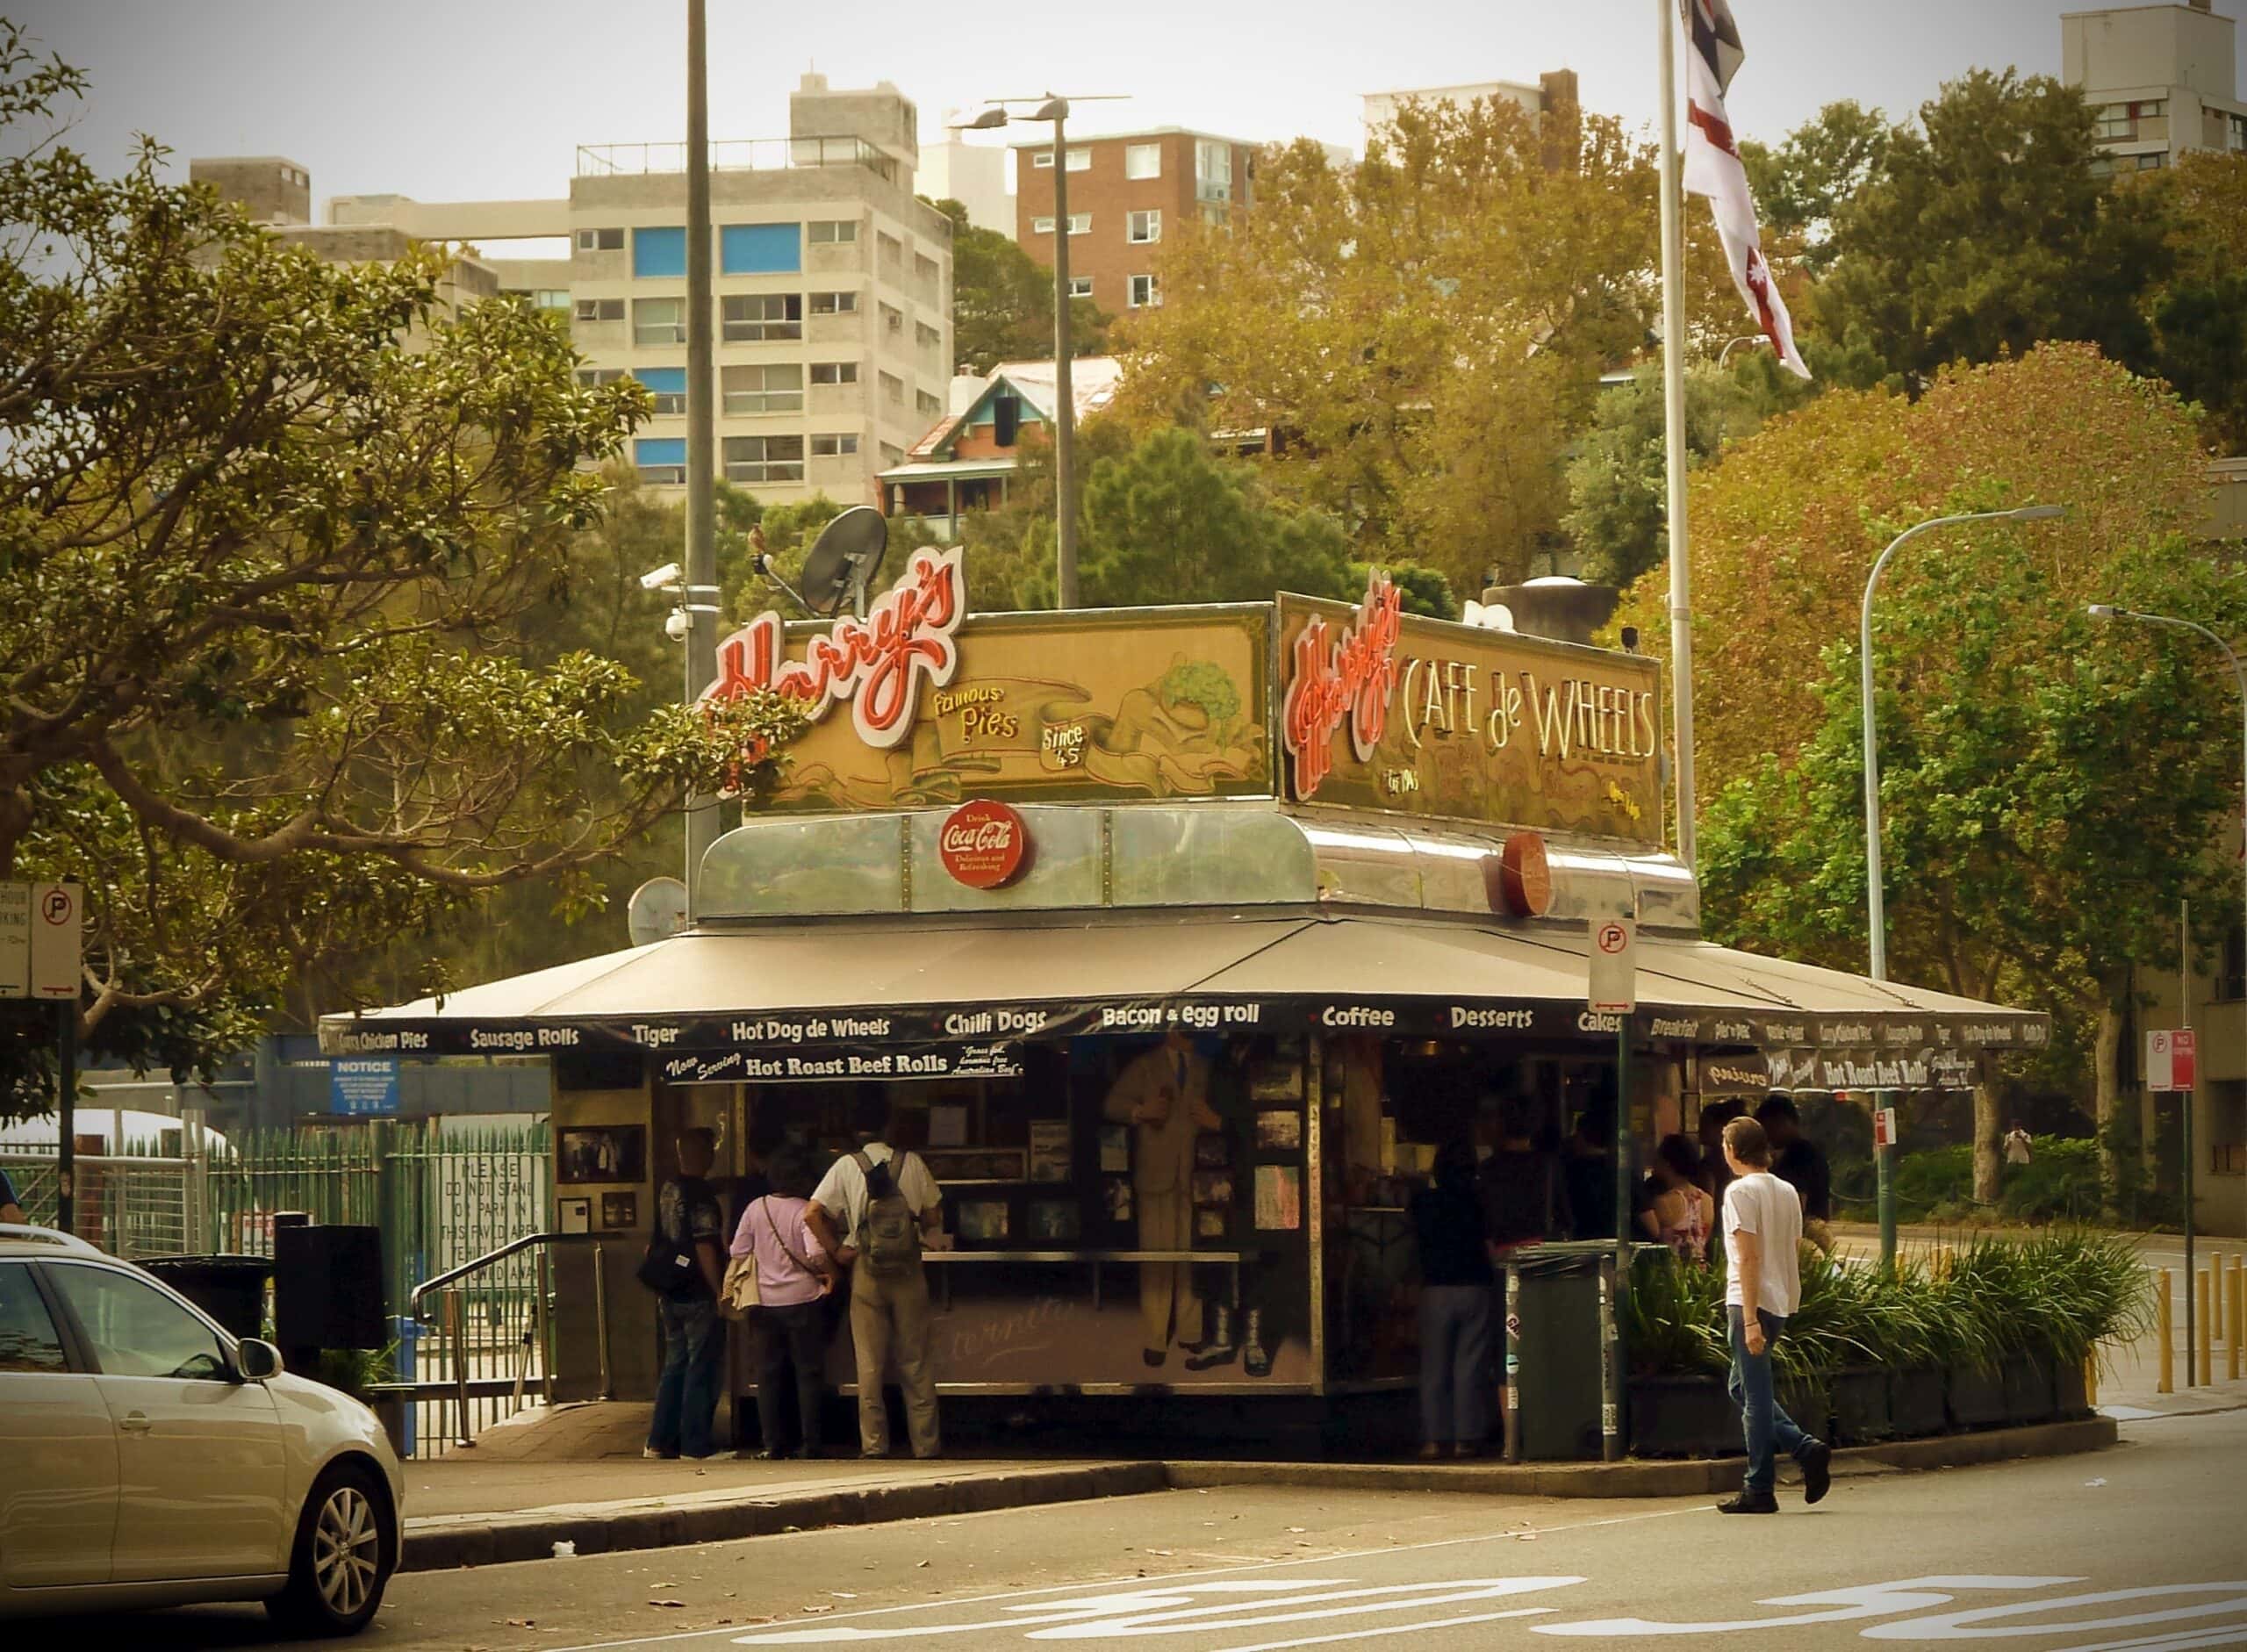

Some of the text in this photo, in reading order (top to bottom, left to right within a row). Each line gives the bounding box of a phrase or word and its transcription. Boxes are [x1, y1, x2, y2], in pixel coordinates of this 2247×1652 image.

[705, 558, 955, 791] Harry's
[933, 687, 1005, 718] Famous
[1404, 658, 1655, 758] CAFE de WHEELS
[961, 706, 1018, 744] Pies
[1042, 725, 1083, 751] Since
[966, 814, 990, 822] Drink
[945, 1011, 1047, 1034] Chilli Dogs
[1102, 1003, 1260, 1028] Bacon & egg roll
[1322, 1006, 1395, 1026] Coffee
[1451, 1006, 1533, 1029] Desserts
[1578, 1012, 1622, 1032] Cakes
[360, 1032, 398, 1050] Chicken
[400, 1031, 428, 1050] Pies
[470, 1028, 579, 1051] Sausage Rolls
[632, 1024, 679, 1048] Tiger
[732, 1018, 891, 1044] Hot Dog de Wheels
[337, 1061, 393, 1073] NOTICE
[666, 1052, 742, 1081] Now Serving
[746, 1055, 947, 1076] Hot Roast Beef Rolls
[1823, 1060, 1845, 1086] Hot
[1844, 1060, 1877, 1086] Roast
[446, 1182, 462, 1196] DO
[470, 1182, 492, 1196] NOT
[442, 1225, 465, 1239] THS
[470, 1225, 506, 1239] PAVD
